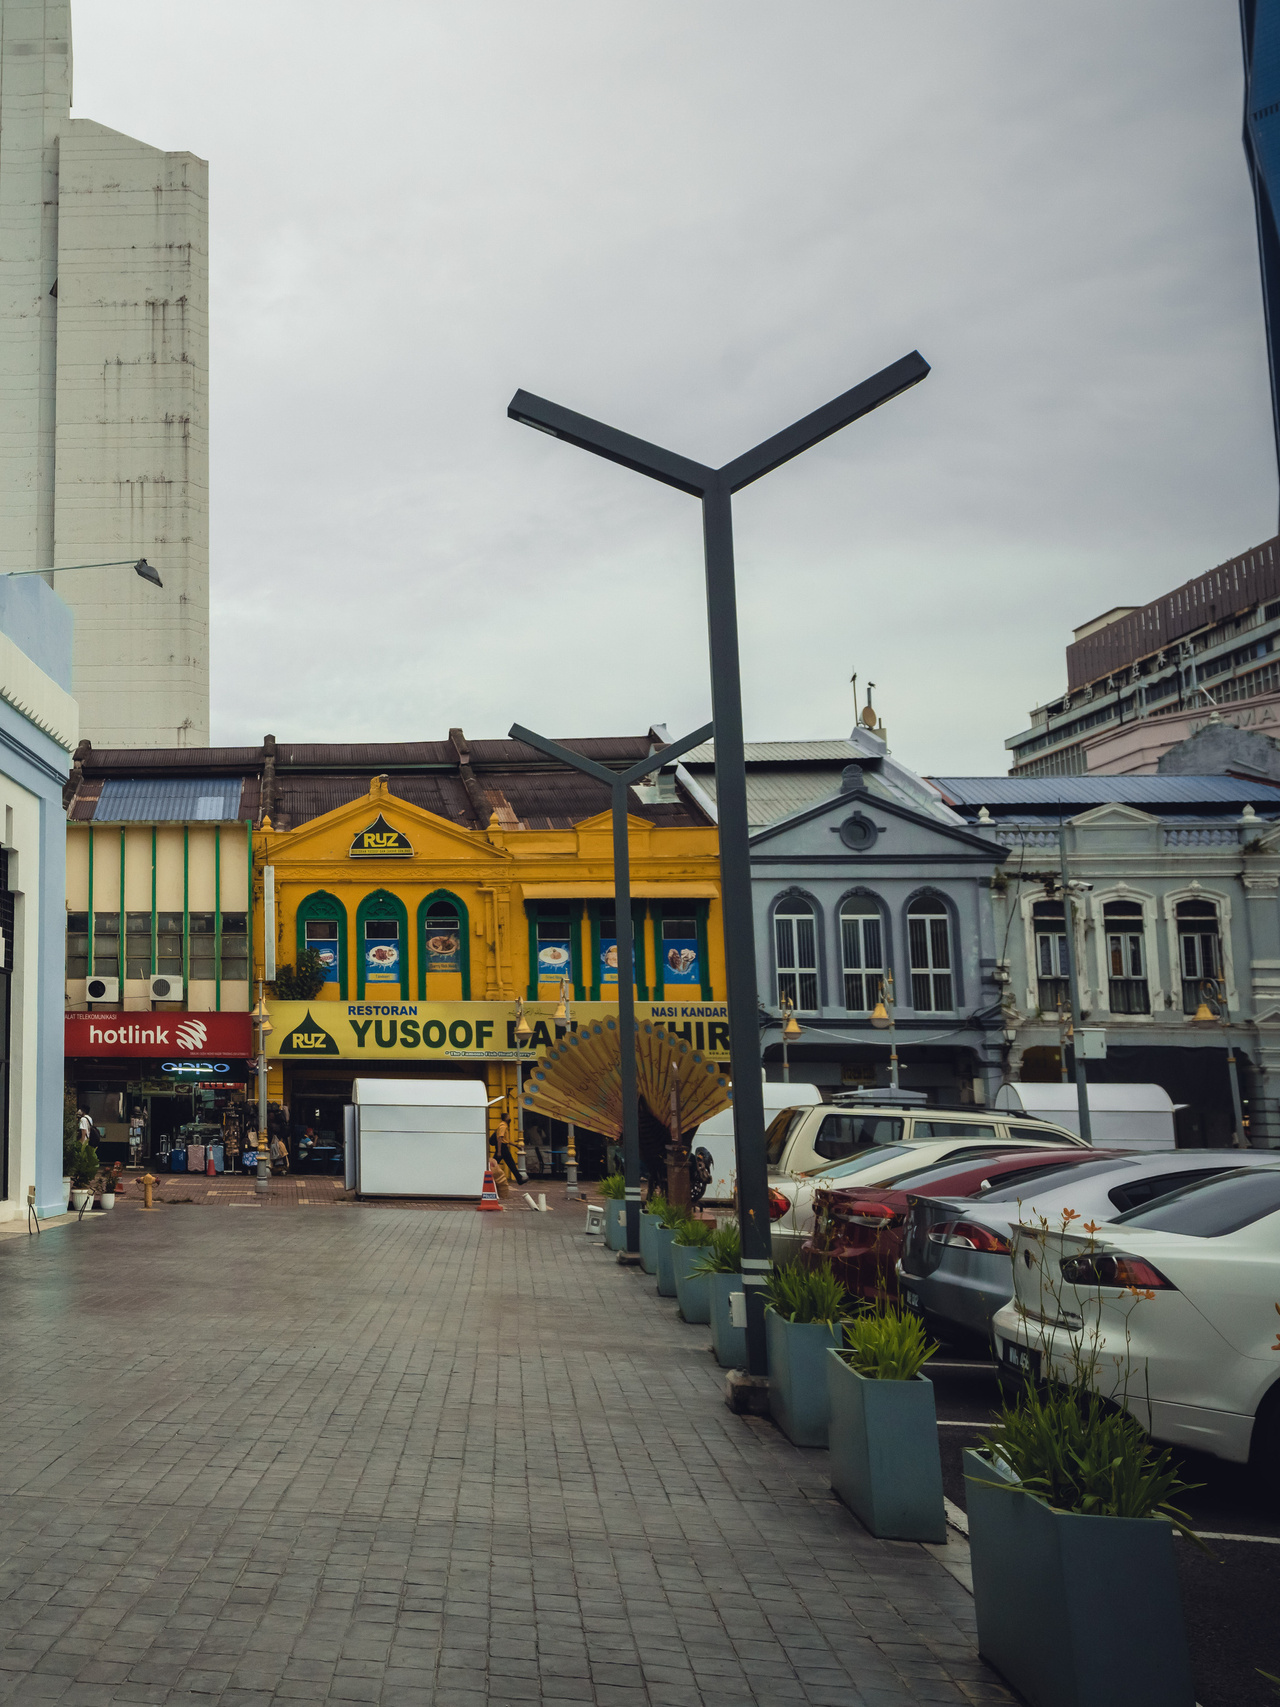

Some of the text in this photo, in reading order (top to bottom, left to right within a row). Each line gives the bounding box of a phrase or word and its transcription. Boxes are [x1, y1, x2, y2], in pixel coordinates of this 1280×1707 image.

[1189, 706, 1277, 737] WMA
[364, 833, 399, 847] RYZ
[348, 1006, 418, 1016] RESTORAN
[651, 1007, 727, 1017] NASI KANDAR
[89, 1025, 169, 1044] hotlink
[292, 1033, 327, 1049] RYZ
[348, 1019, 494, 1049] YUSOOF
